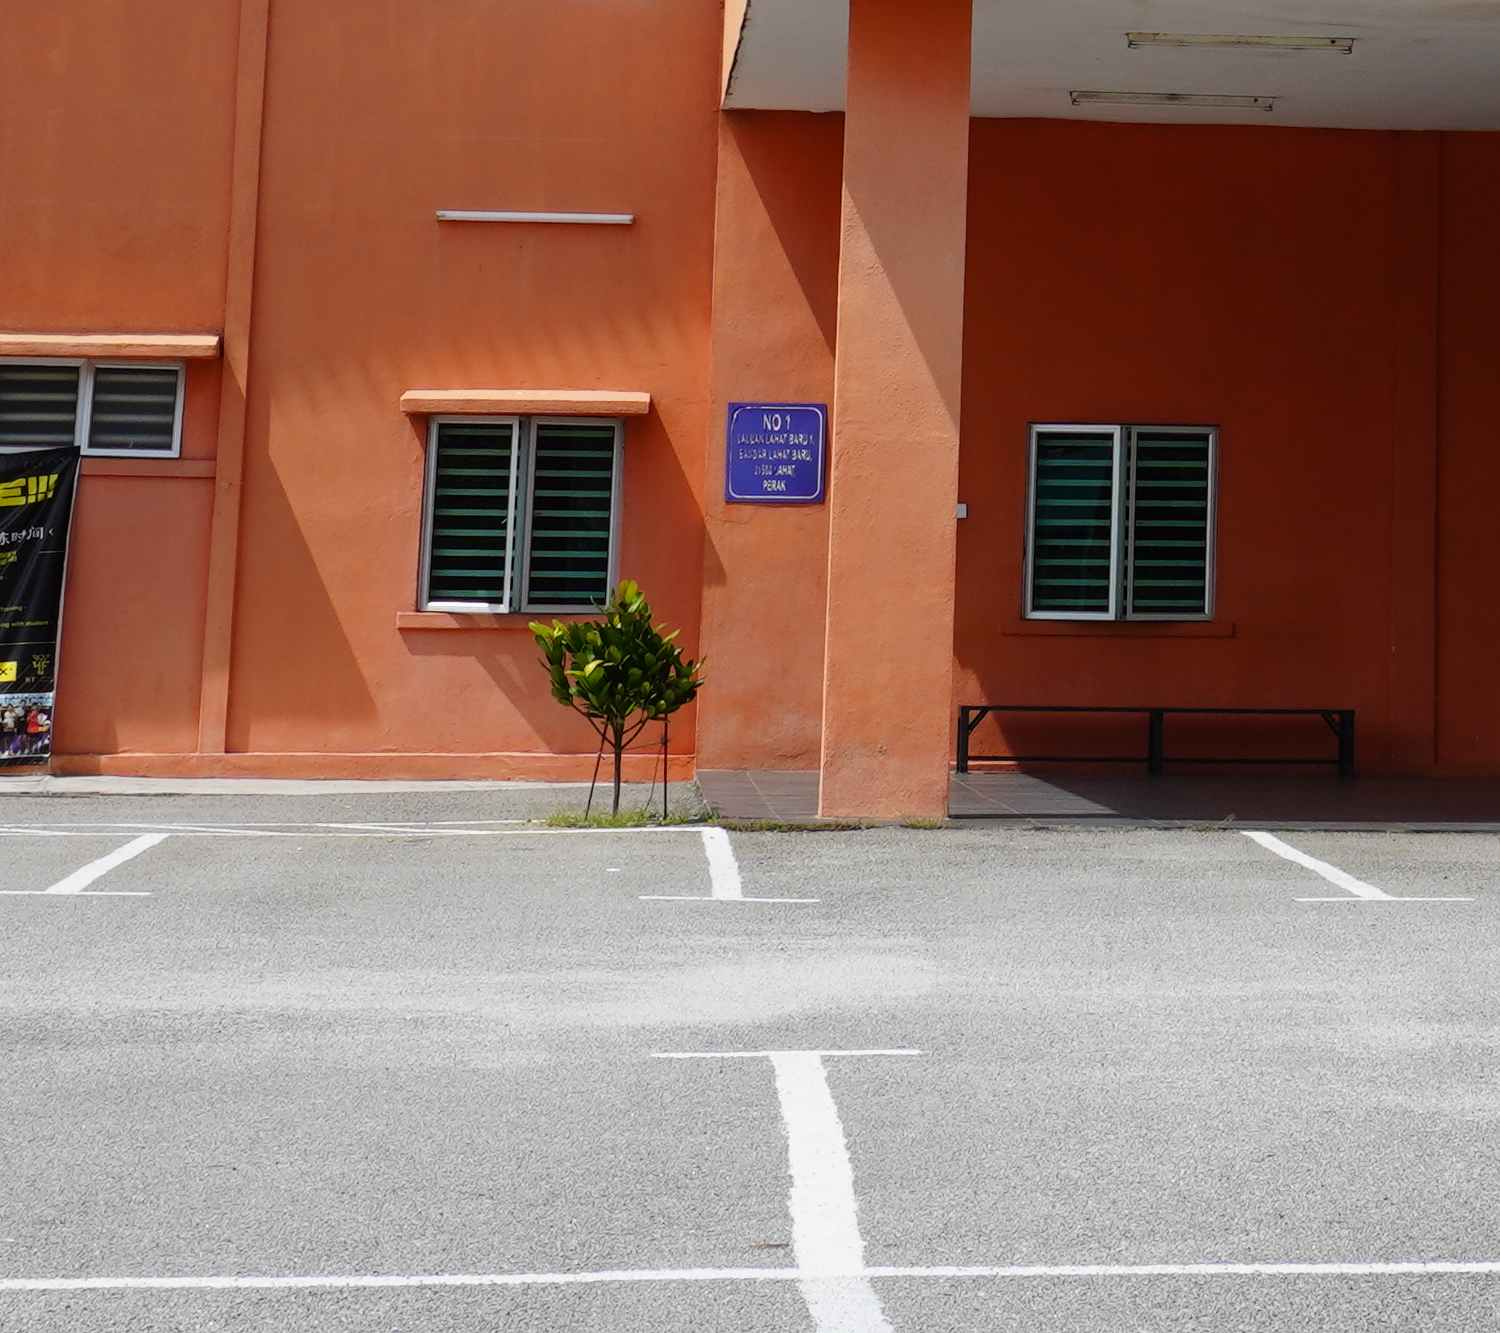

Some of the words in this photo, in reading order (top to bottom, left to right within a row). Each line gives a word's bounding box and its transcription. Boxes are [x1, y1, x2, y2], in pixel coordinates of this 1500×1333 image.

[763, 413, 781, 431] NO
[785, 413, 791, 431] 1
[765, 433, 787, 445] LAHAT
[789, 433, 808, 445] BARU
[739, 448, 767, 460] BANDAR
[768, 449, 790, 461] LAHAT
[763, 479, 787, 492] PERAK
